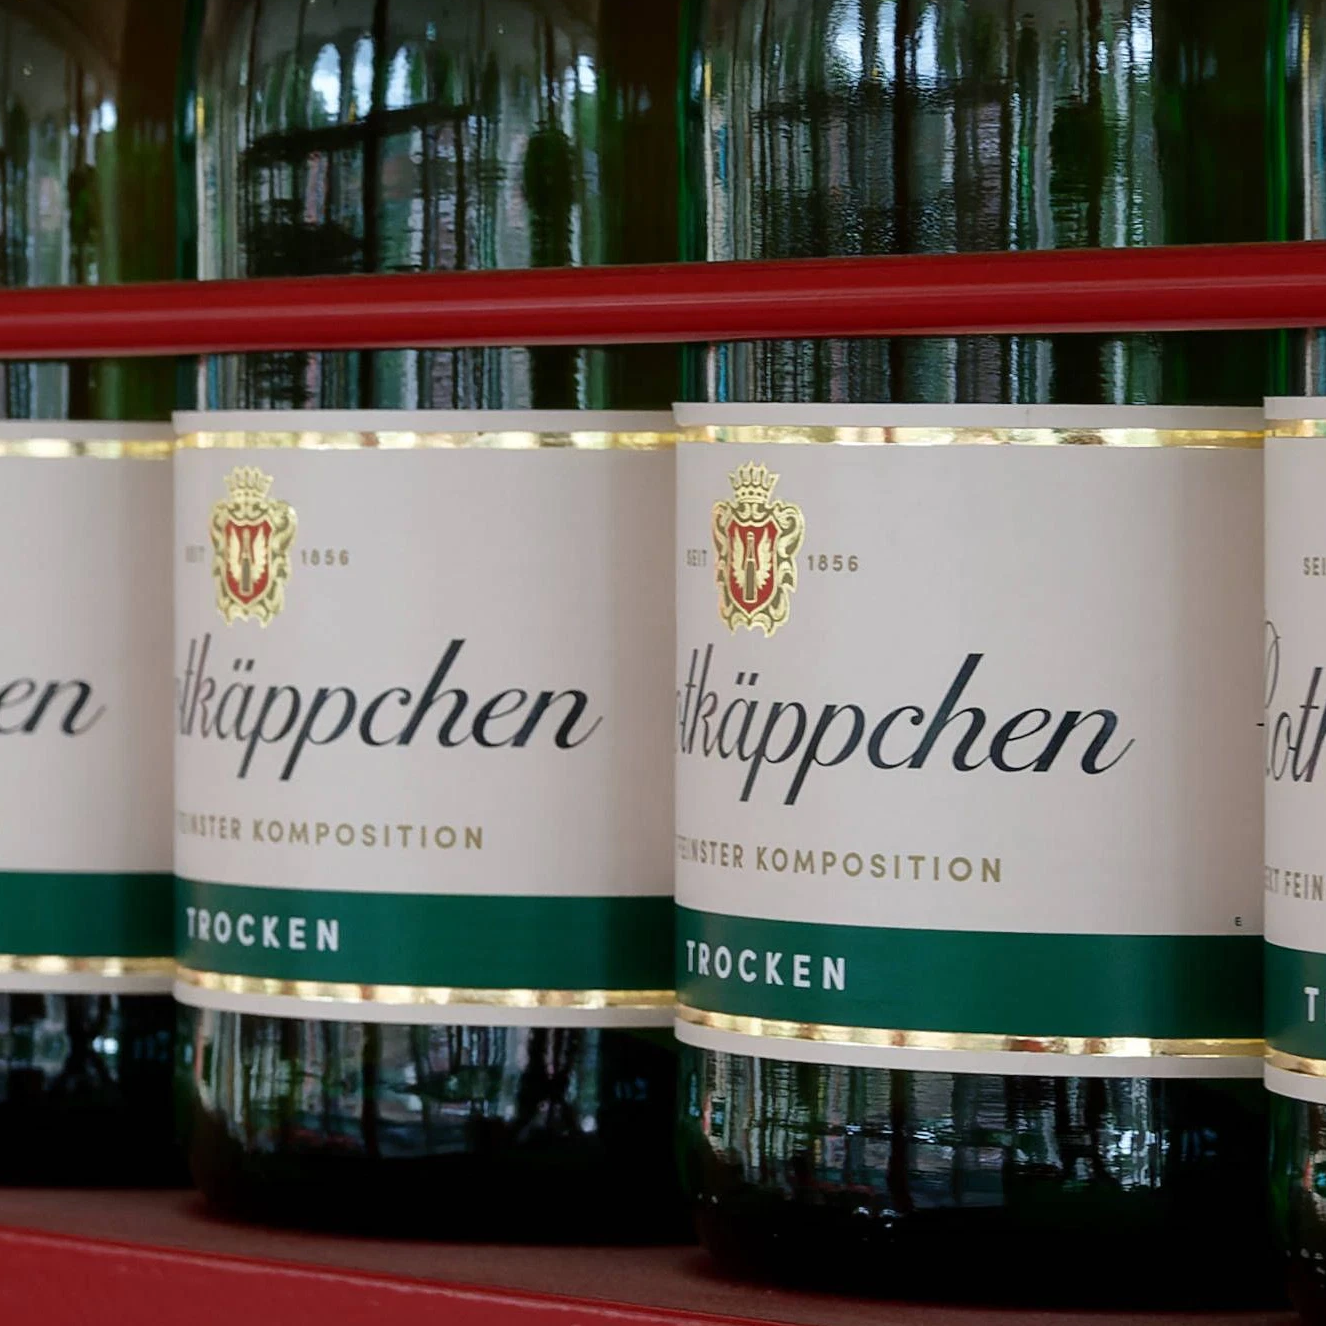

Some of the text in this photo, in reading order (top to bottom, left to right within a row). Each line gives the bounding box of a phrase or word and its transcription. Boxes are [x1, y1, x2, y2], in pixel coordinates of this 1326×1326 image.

[806, 555, 860, 573] 1856
[174, 632, 605, 782] tkäppchen
[674, 643, 1136, 806] tkäppchen
[252, 818, 484, 851] KOMPOSITION
[756, 846, 1003, 884] KOMPOSITION
[186, 906, 341, 952] TROCKEN
[686, 939, 847, 992] TROCKEN
